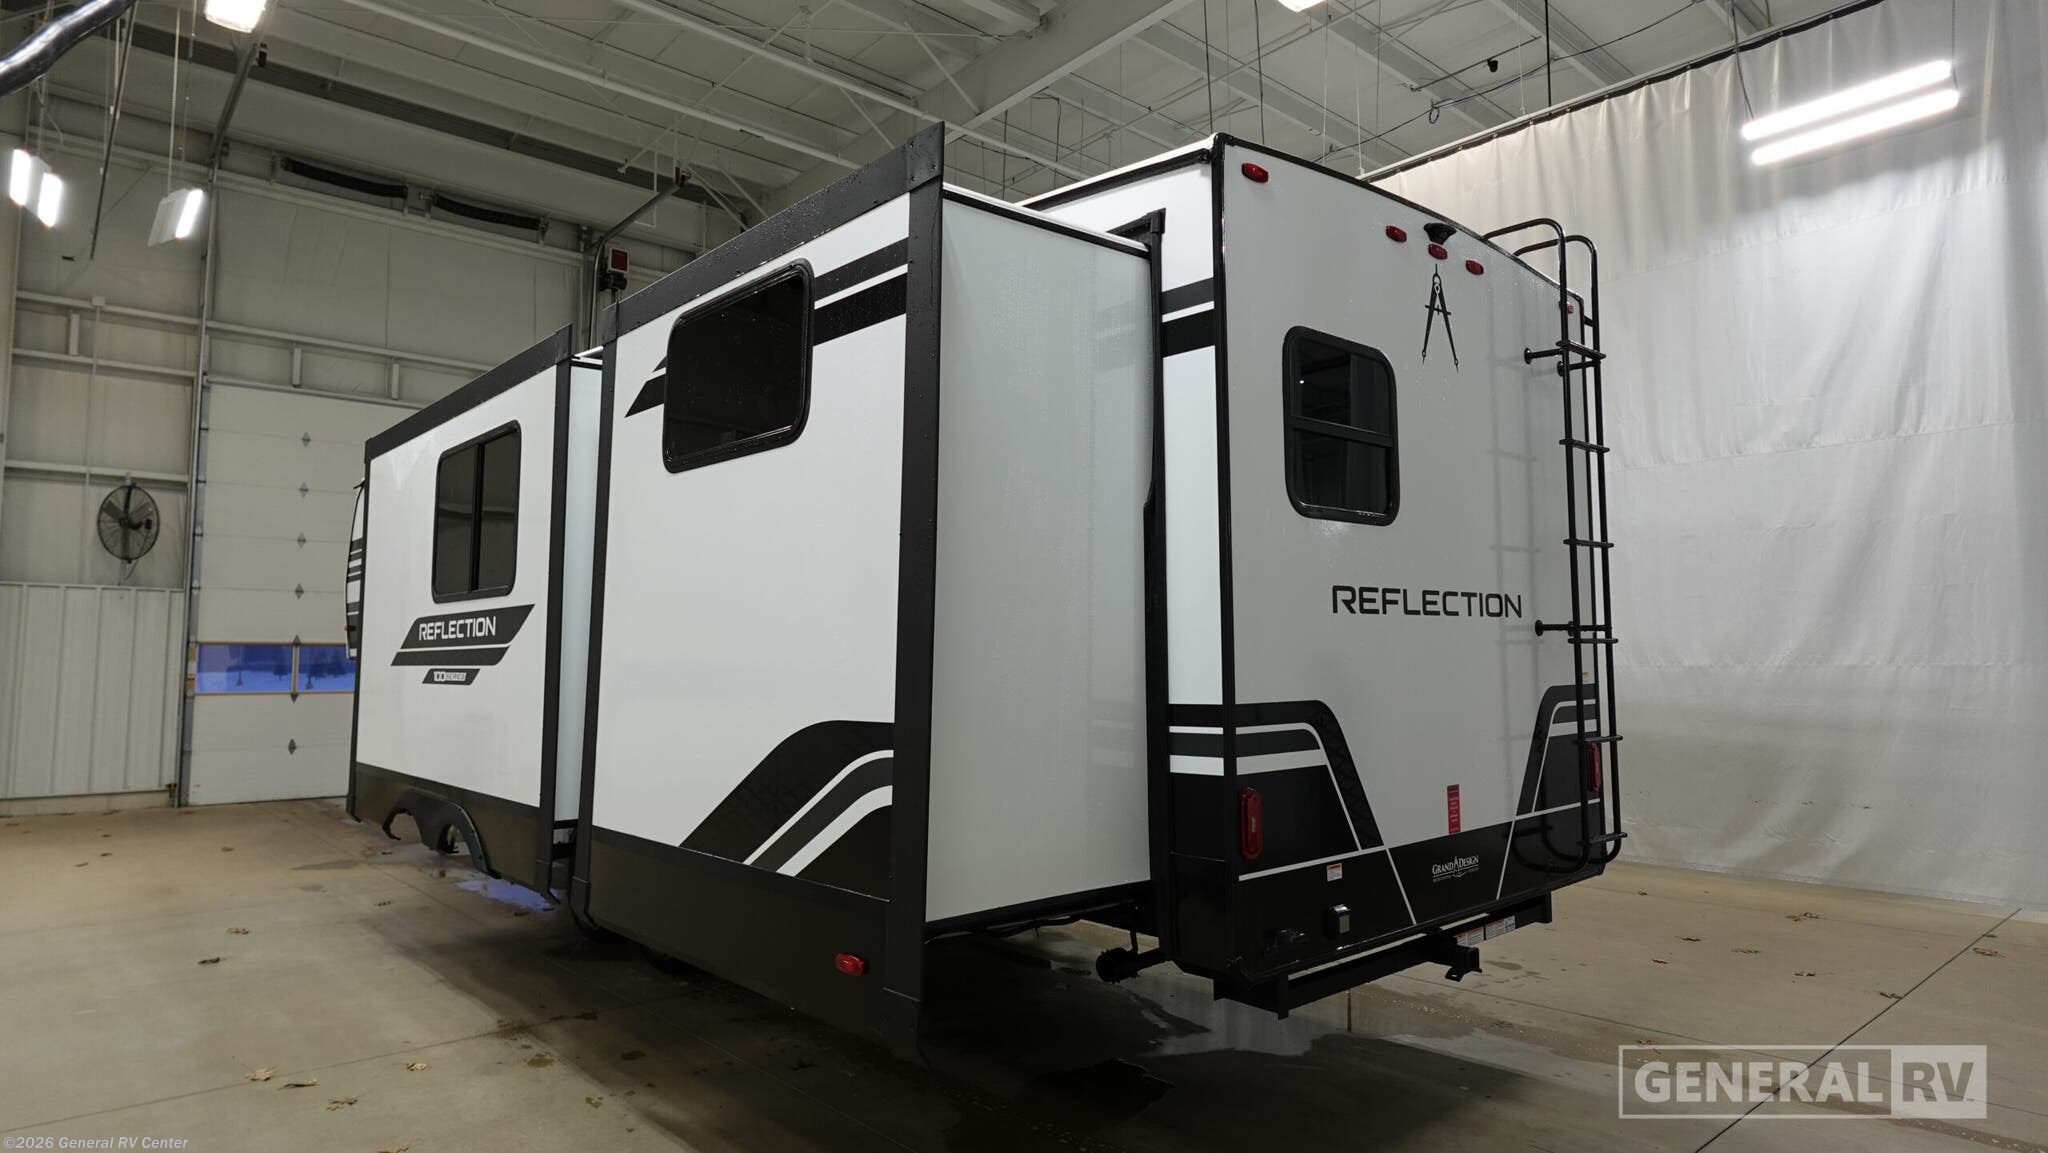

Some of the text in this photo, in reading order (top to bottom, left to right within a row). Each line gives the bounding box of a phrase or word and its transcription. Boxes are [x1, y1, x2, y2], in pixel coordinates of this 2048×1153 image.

[1332, 585, 1522, 618] REFLECTION
[419, 616, 496, 640] REFLECTION
[1432, 862, 1454, 875] GRAND
